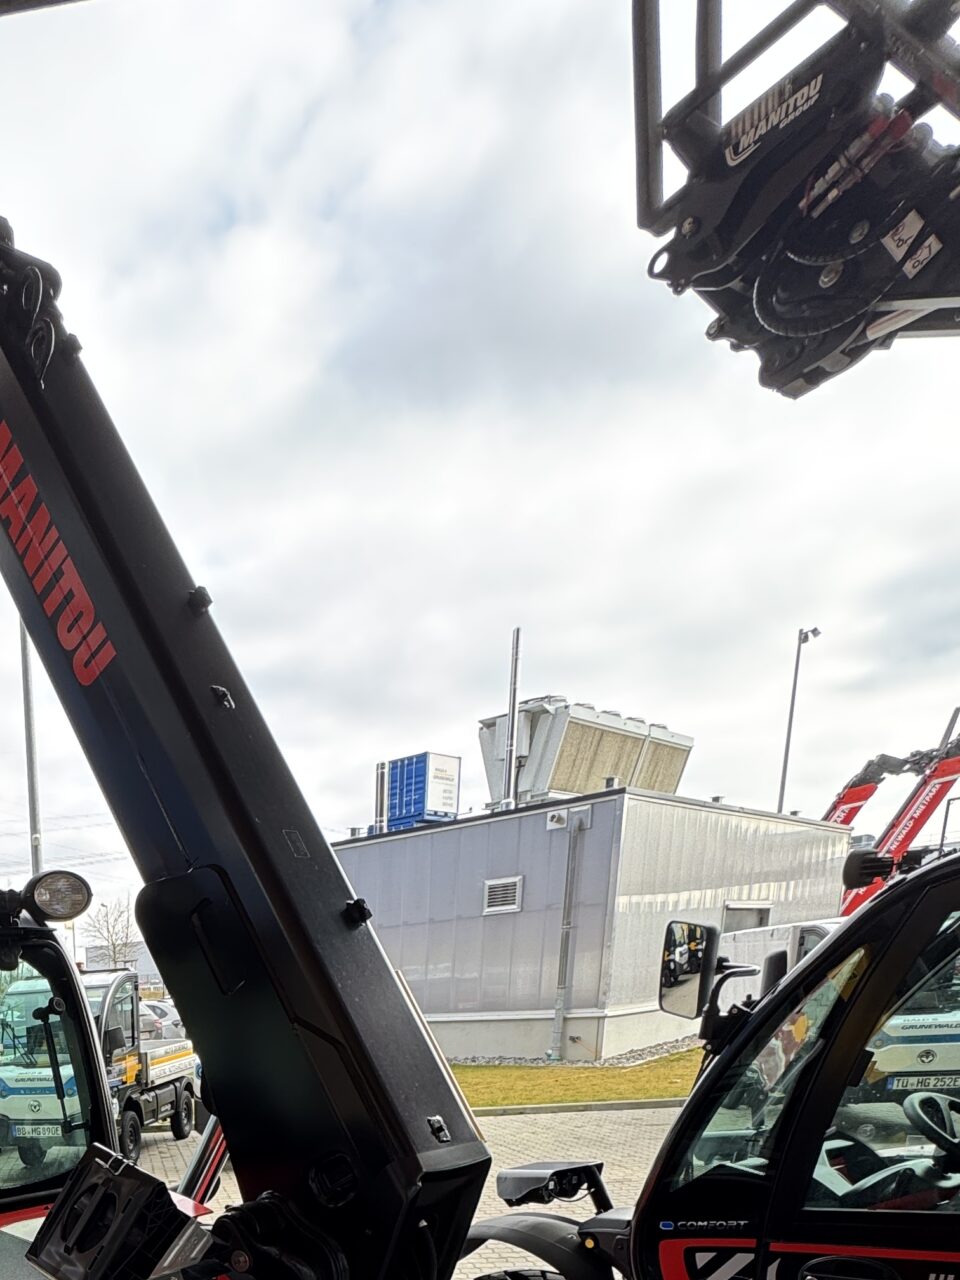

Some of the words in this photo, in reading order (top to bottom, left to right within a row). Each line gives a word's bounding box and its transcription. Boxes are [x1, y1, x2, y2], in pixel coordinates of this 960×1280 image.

[738, 73, 824, 153] MANITOU
[779, 92, 820, 129] GROUP
[895, 1077, 909, 1089] TÜ
[916, 1077, 931, 1088] HG
[933, 1077, 960, 1087] 252E
[677, 1220, 749, 1231] COMFORT
